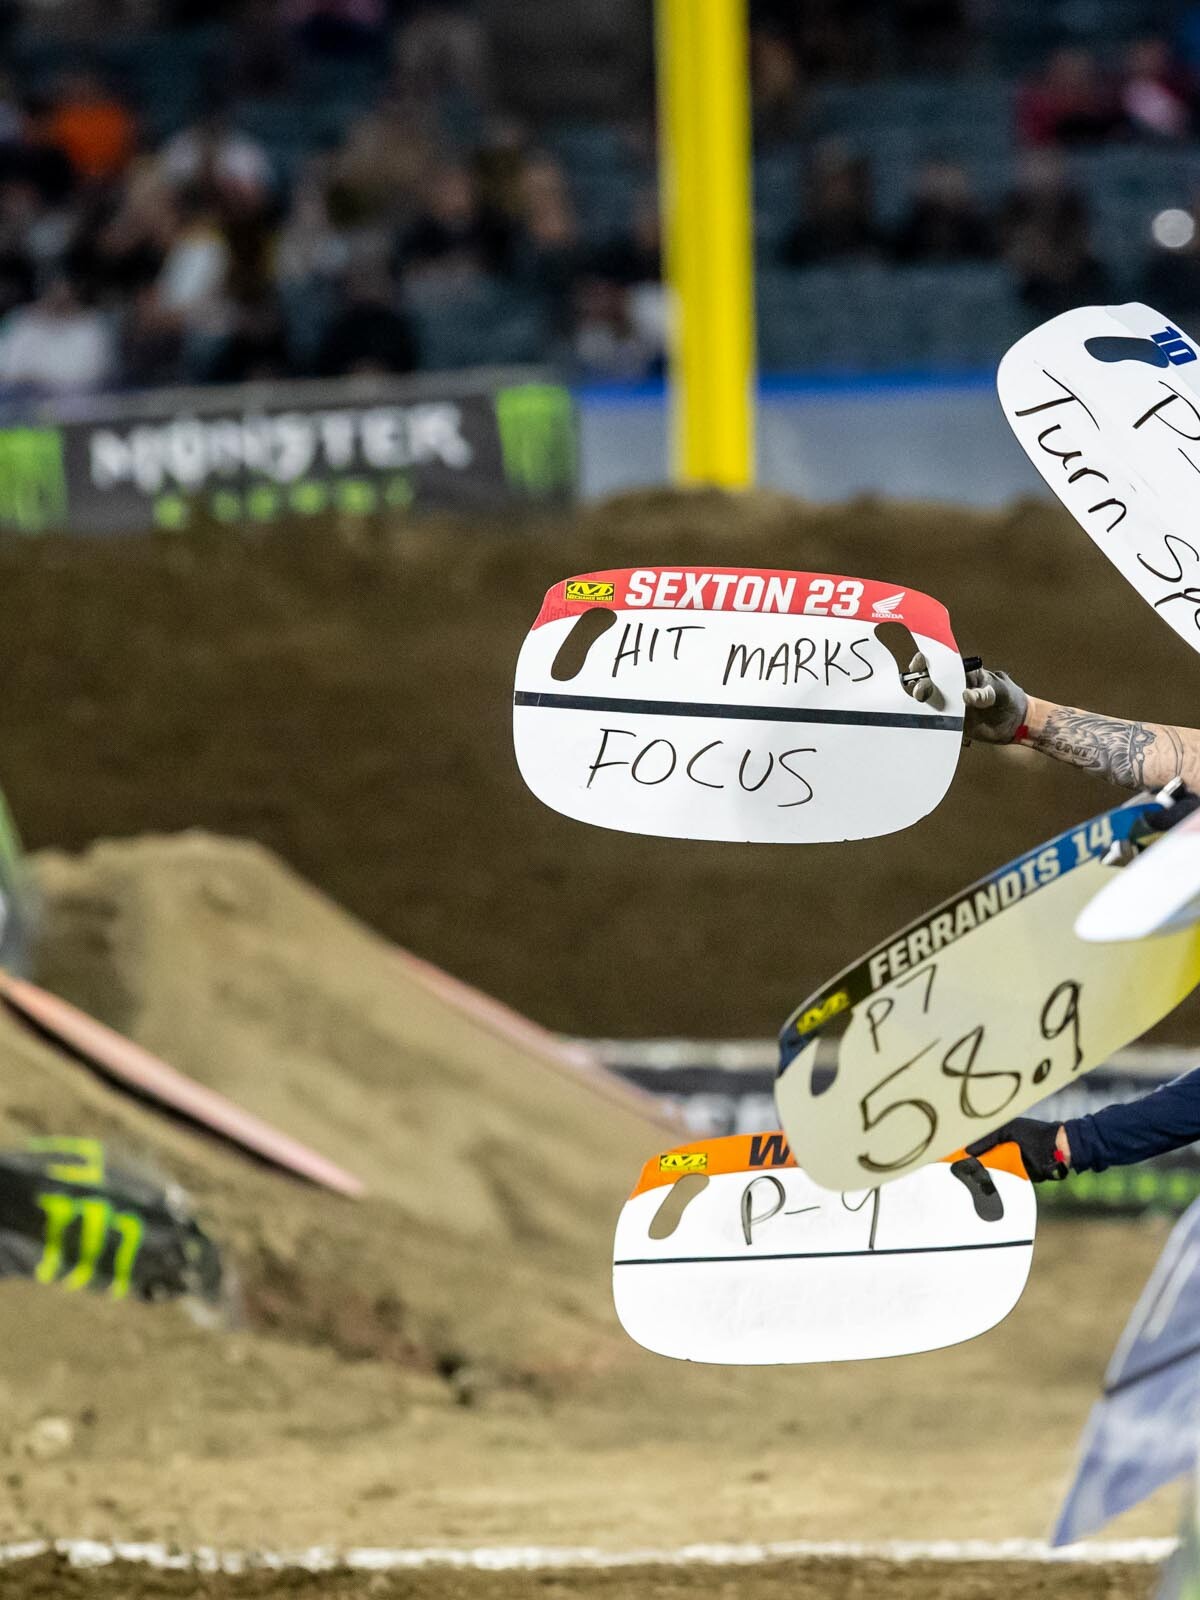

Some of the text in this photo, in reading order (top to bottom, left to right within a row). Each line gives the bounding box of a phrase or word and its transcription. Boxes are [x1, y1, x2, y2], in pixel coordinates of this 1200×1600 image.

[1149, 325, 1198, 366] 10
[1015, 368, 1128, 533] Turn
[624, 570, 797, 614] SEXTON
[806, 579, 865, 617] 23
[871, 612, 904, 620] HONDA
[612, 621, 876, 686] HIT MARKS
[586, 728, 818, 808] FOCUS
[868, 815, 1114, 991] FERRANDIS 14
[857, 978, 1084, 1173] 58.9
